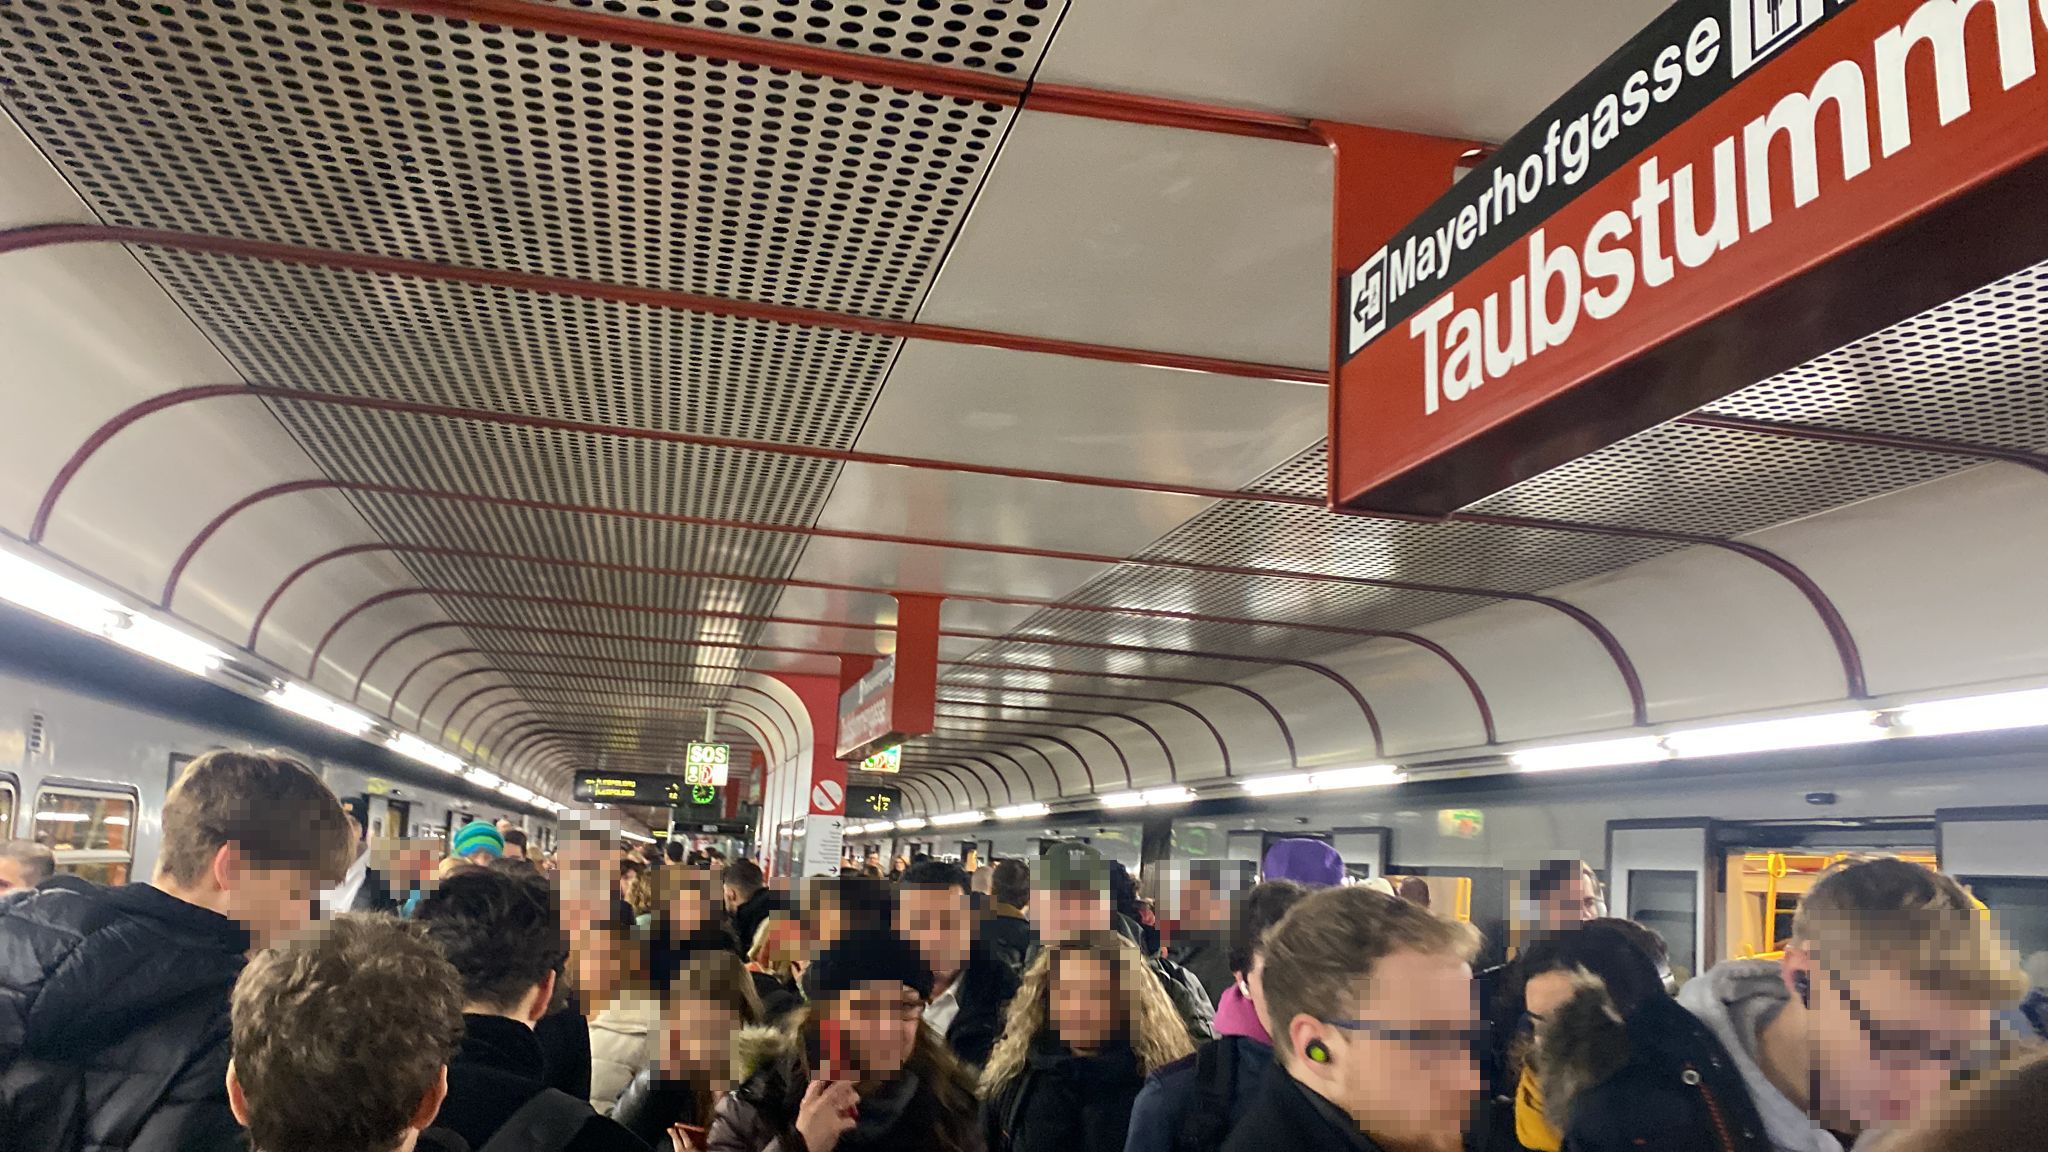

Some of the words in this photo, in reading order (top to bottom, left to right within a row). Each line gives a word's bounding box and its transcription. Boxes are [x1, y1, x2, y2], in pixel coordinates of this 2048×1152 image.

[1389, 16, 1721, 303] Mayerhofgasse
[1409, 0, 2048, 416] Taubstumm
[690, 745, 727, 763] SOS
